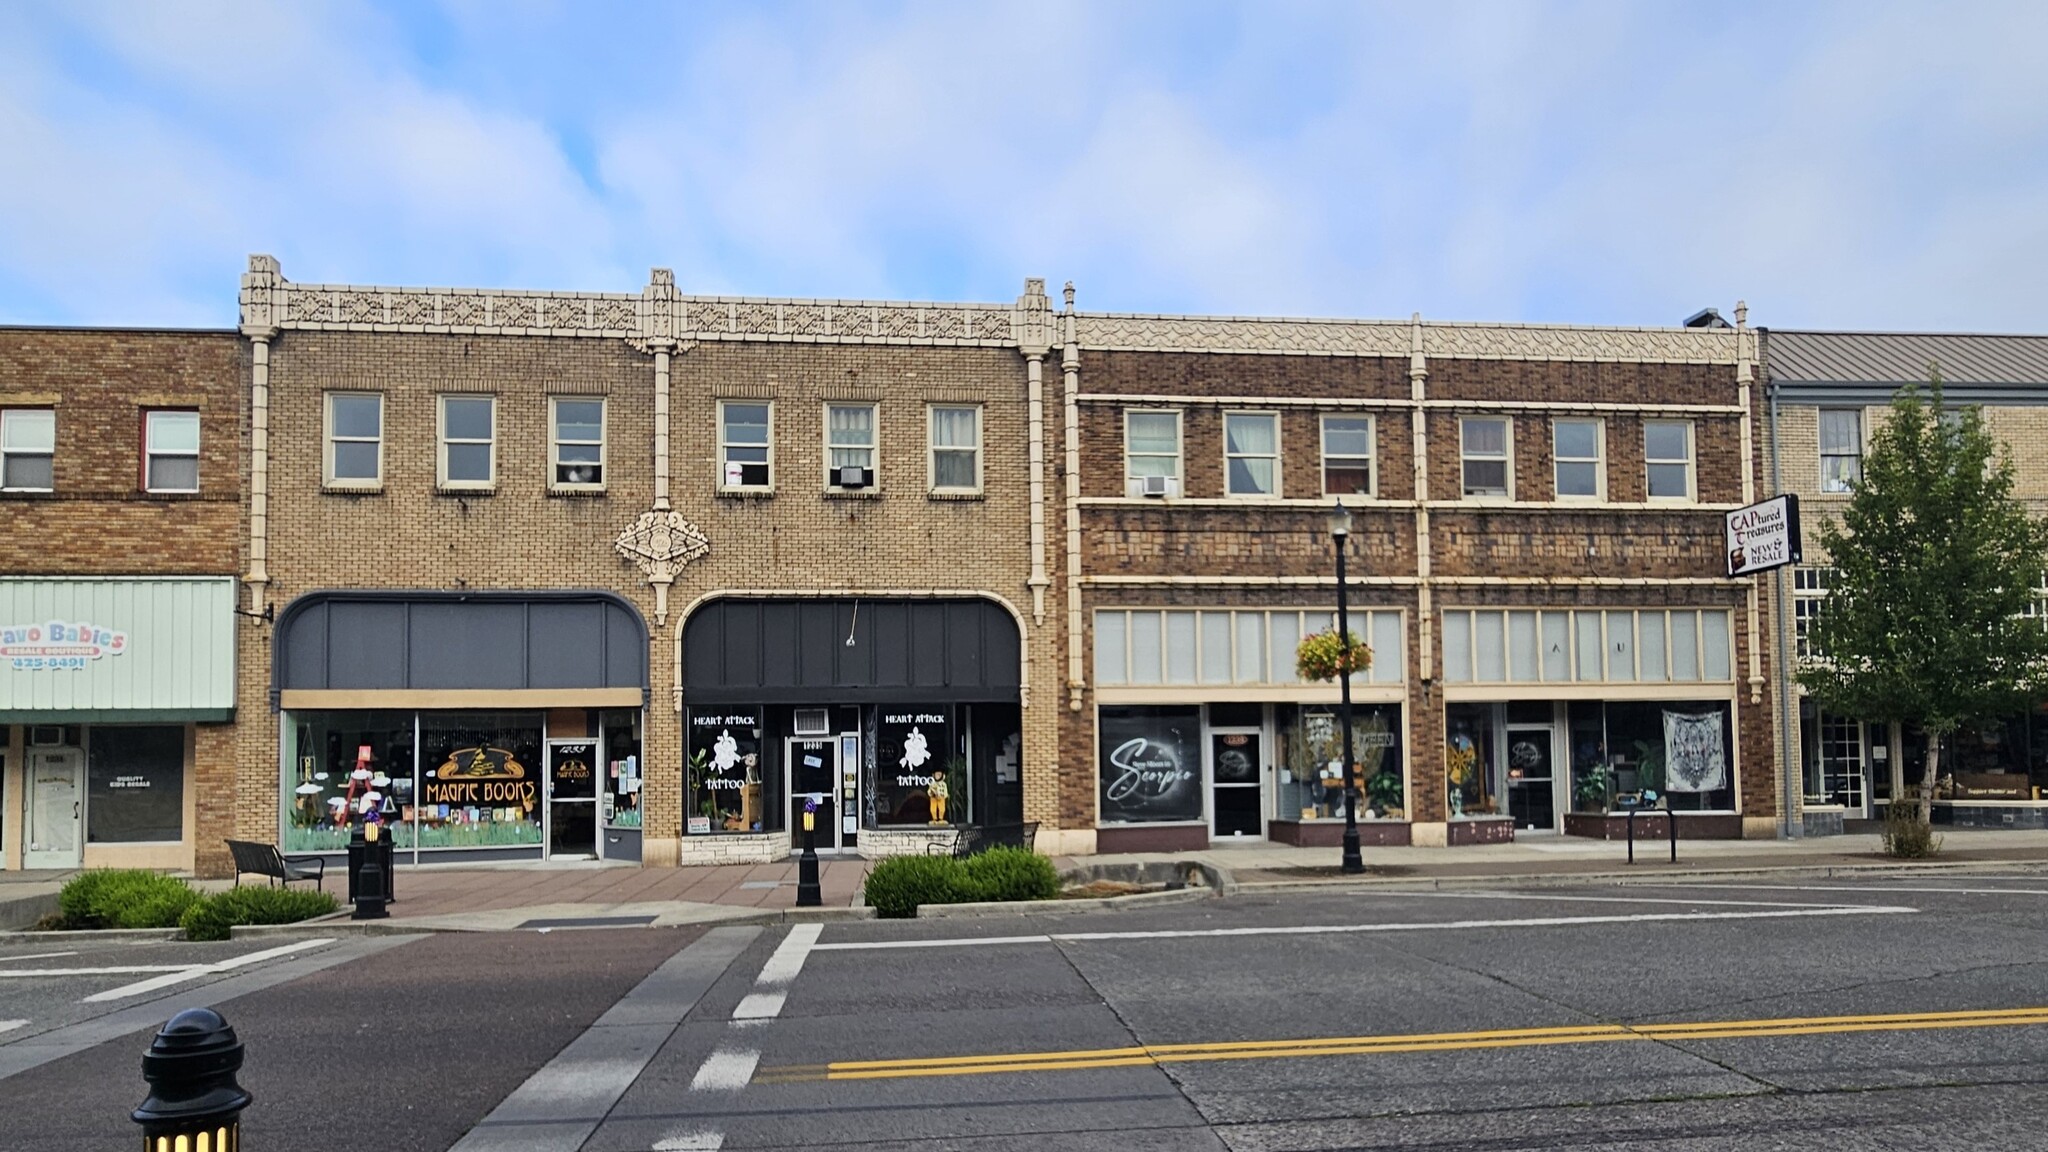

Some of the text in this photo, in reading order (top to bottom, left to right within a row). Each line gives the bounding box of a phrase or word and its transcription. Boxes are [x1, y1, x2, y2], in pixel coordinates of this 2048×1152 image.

[1735, 521, 1785, 546] Treasures
[1751, 543, 1773, 555] NEW
[1752, 550, 1784, 565] RESALE
[49, 624, 124, 649] Babies
[693, 715, 755, 725] HEART ATTACK
[885, 714, 945, 724] HEART ATTACK
[1107, 738, 1194, 800] Scorpio
[705, 778, 745, 791] TATTOO
[896, 774, 936, 787] TATTOO
[426, 781, 536, 803] MAGPIE BOOKS
